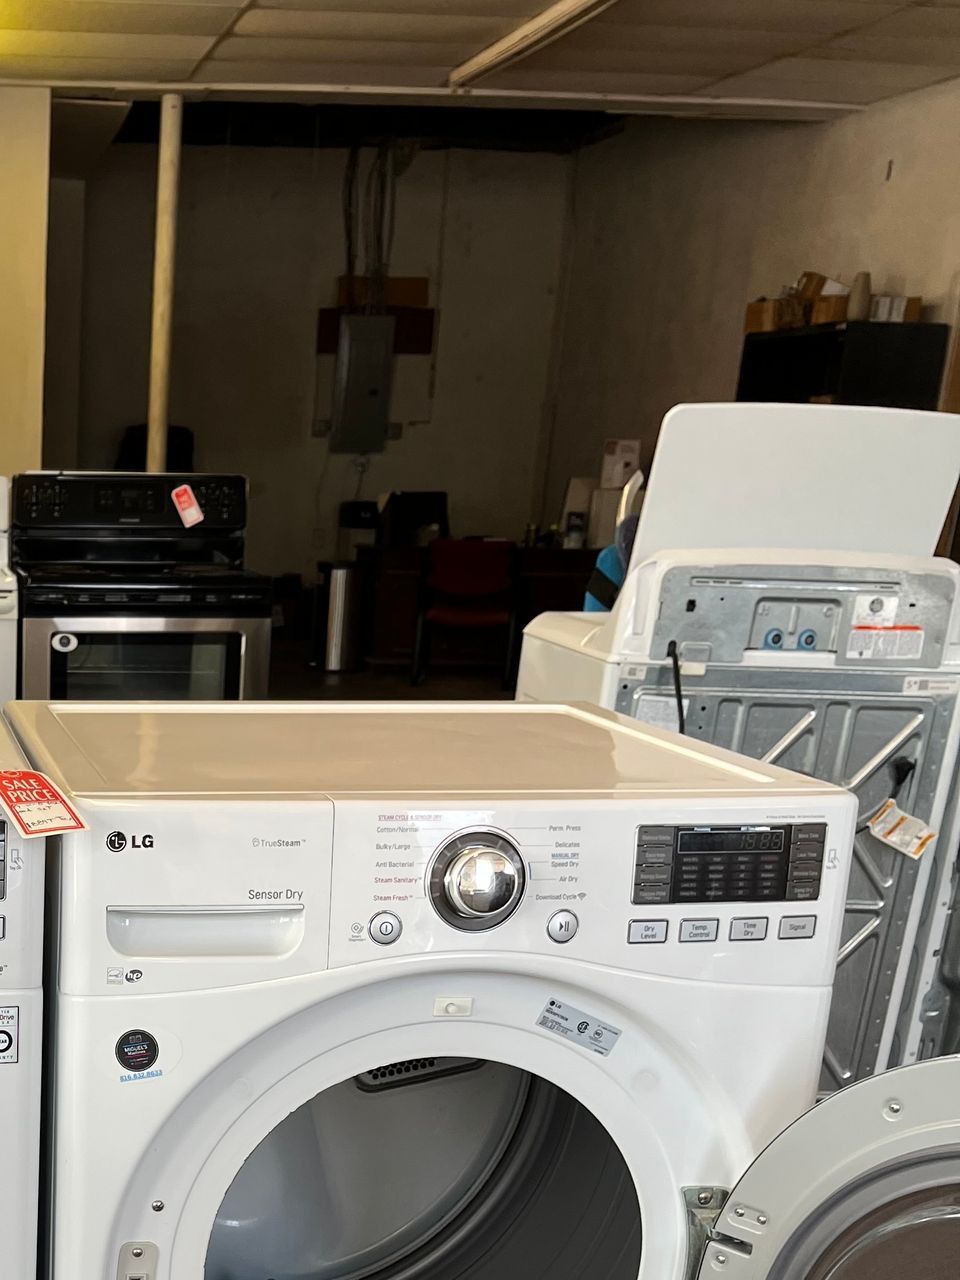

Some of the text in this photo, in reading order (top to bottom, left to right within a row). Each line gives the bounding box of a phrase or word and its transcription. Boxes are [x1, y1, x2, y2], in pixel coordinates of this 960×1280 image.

[759, 605, 769, 617] H
[2, 779, 42, 790] SALE
[7, 789, 56, 802] PRICE
[132, 835, 153, 849] LG
[248, 889, 303, 900] Sensor Dry
[789, 923, 806, 931] Signal
